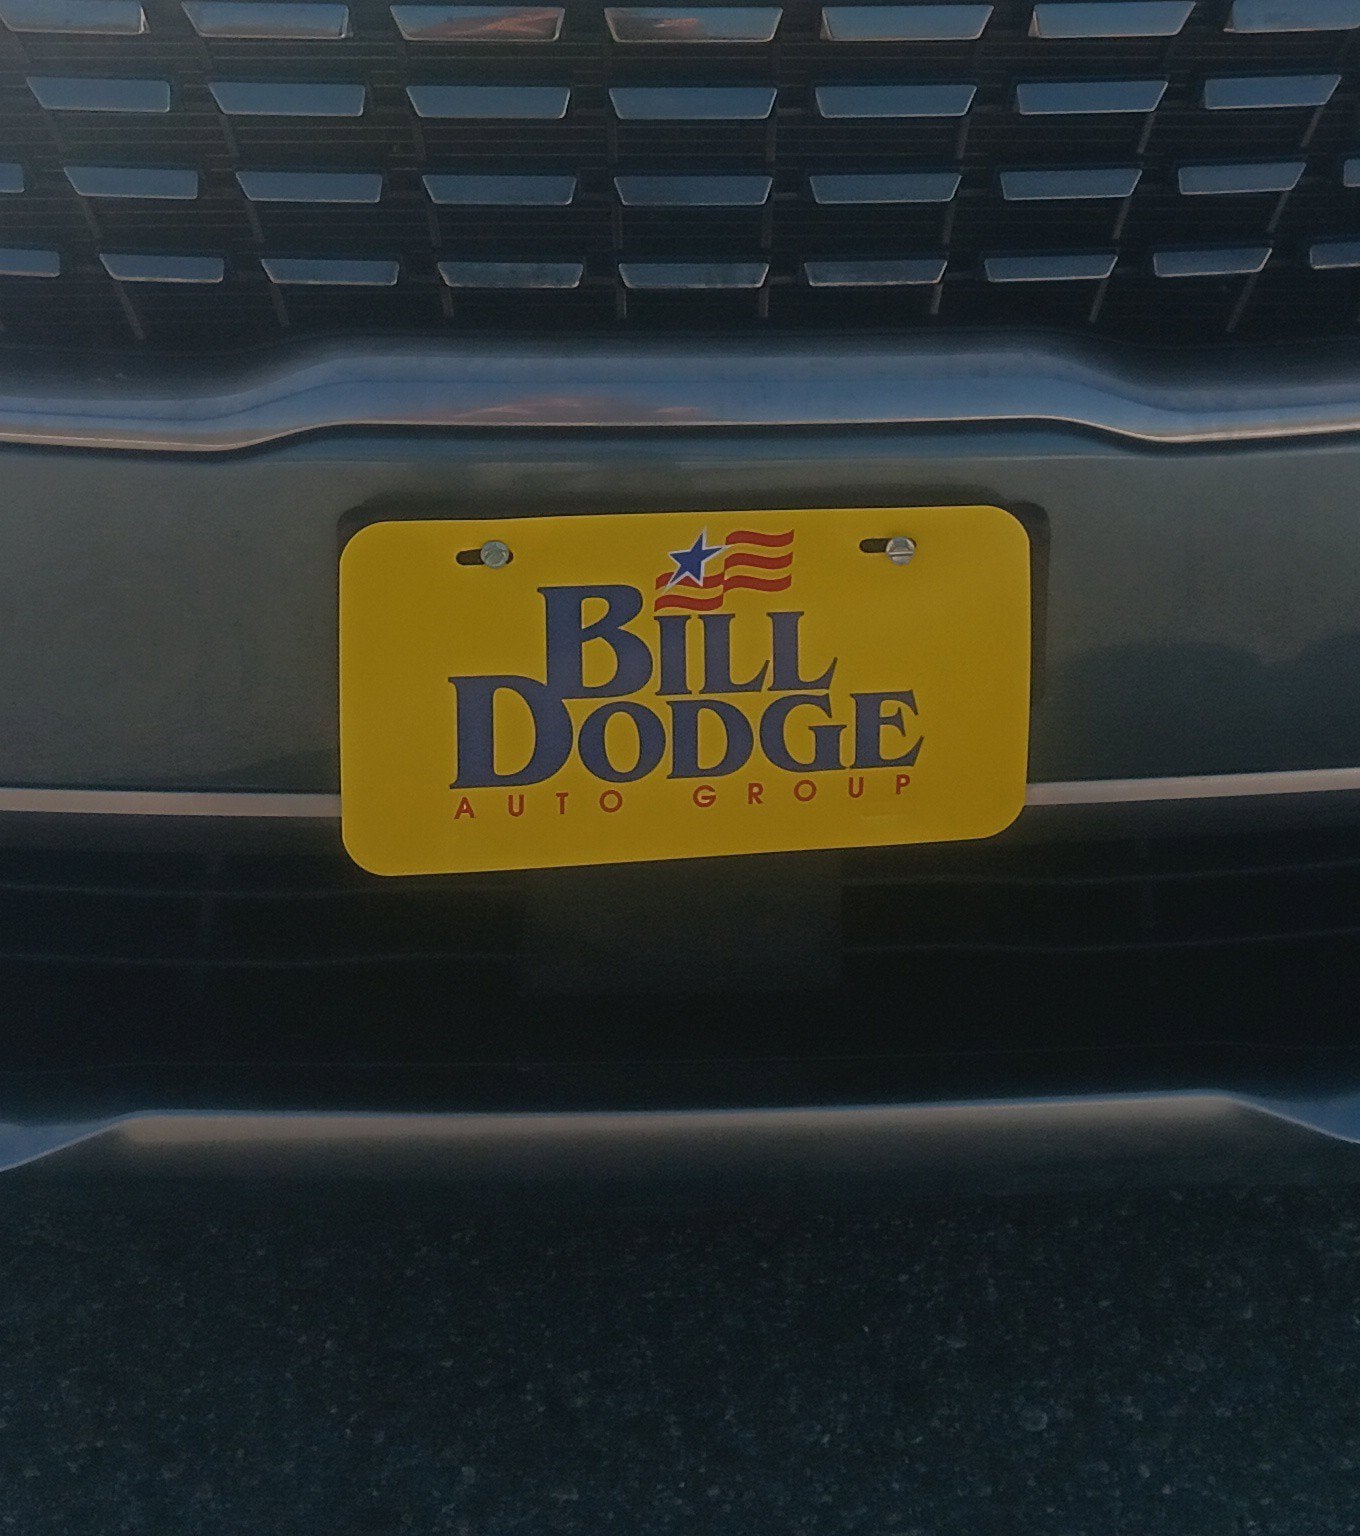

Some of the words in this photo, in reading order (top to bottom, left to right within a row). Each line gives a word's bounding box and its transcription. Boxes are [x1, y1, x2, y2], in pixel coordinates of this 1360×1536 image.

[536, 583, 837, 701] BILL
[447, 674, 924, 789] DODGE
[453, 789, 624, 820] AUTO
[692, 774, 913, 808] GROUP
